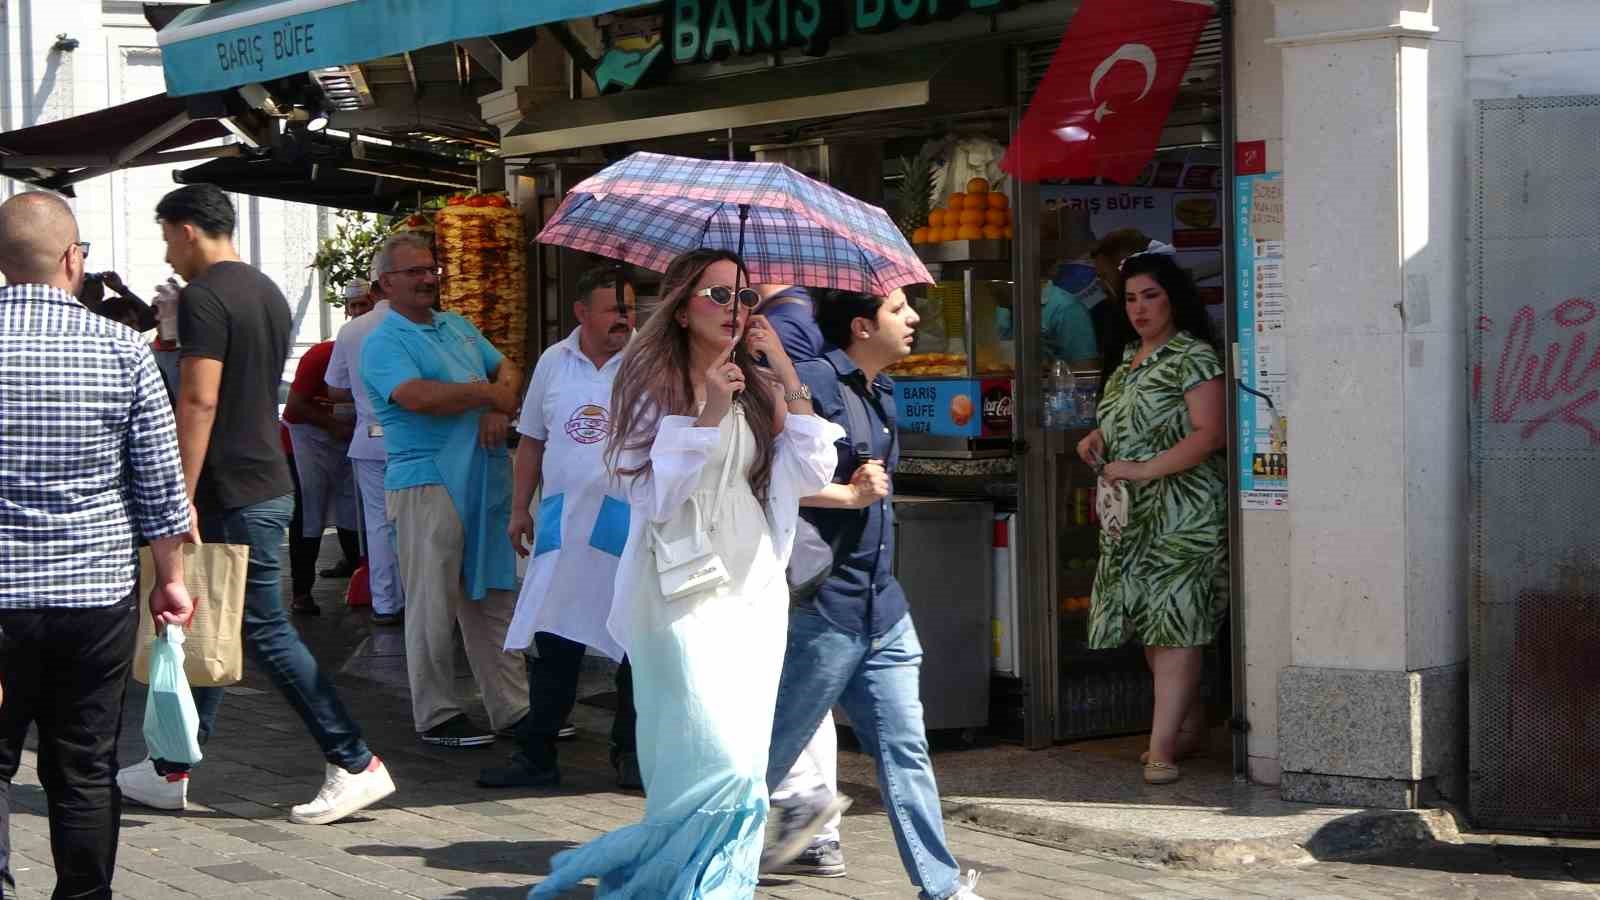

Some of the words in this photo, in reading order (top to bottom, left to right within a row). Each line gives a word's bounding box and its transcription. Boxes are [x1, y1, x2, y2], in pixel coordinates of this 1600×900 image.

[216, 34, 265, 72] BARIŞ
[273, 22, 315, 61] BÜFE
[1106, 192, 1155, 211] BÜFE
